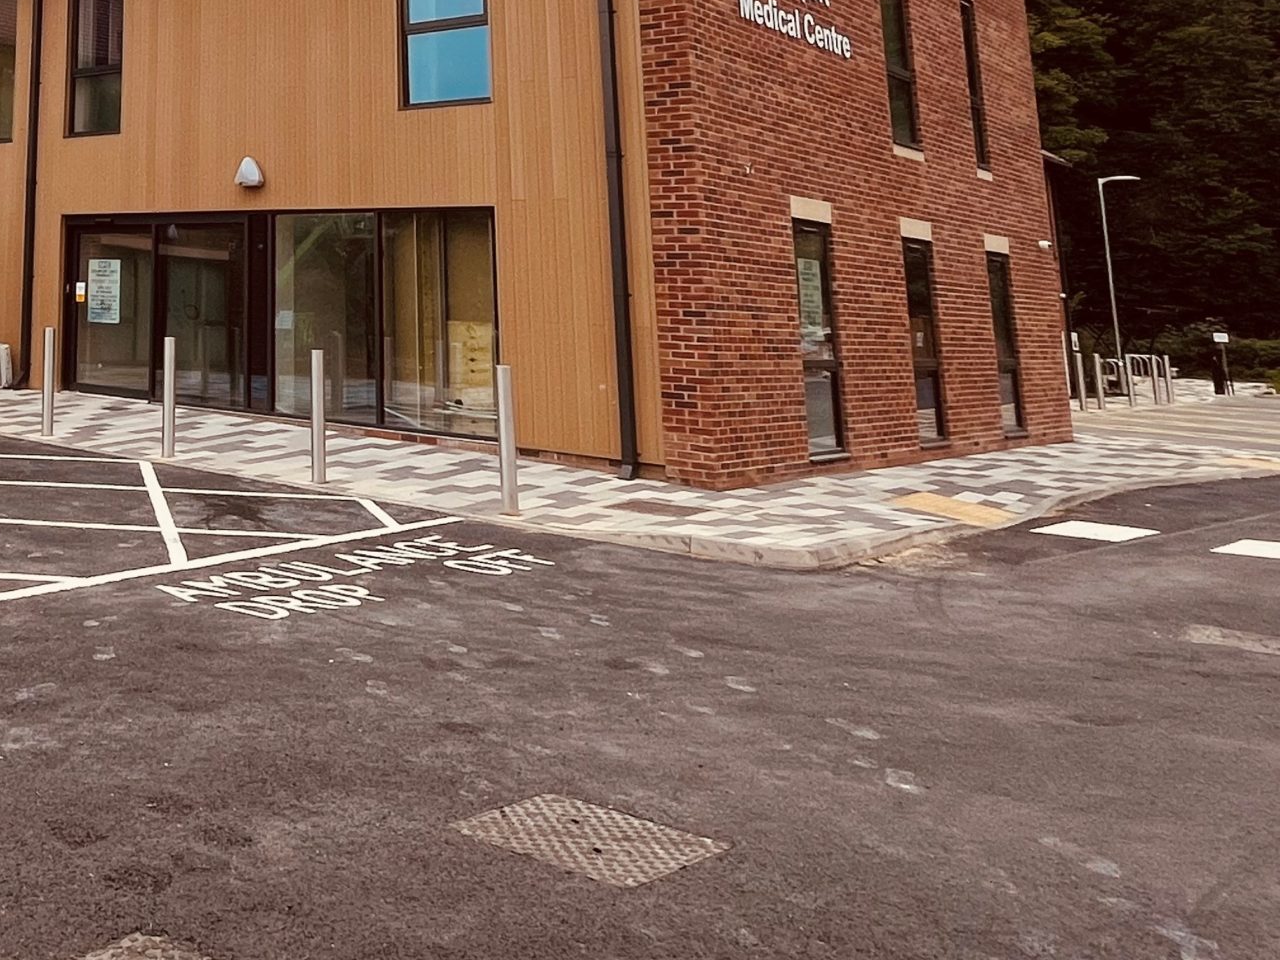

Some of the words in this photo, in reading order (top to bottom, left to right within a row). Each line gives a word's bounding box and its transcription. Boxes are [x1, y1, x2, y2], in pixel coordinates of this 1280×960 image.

[803, 13, 851, 59] Centre
[155, 535, 494, 602] AMBULANCE
[215, 584, 386, 620] DROP
[443, 548, 555, 576] OFF
